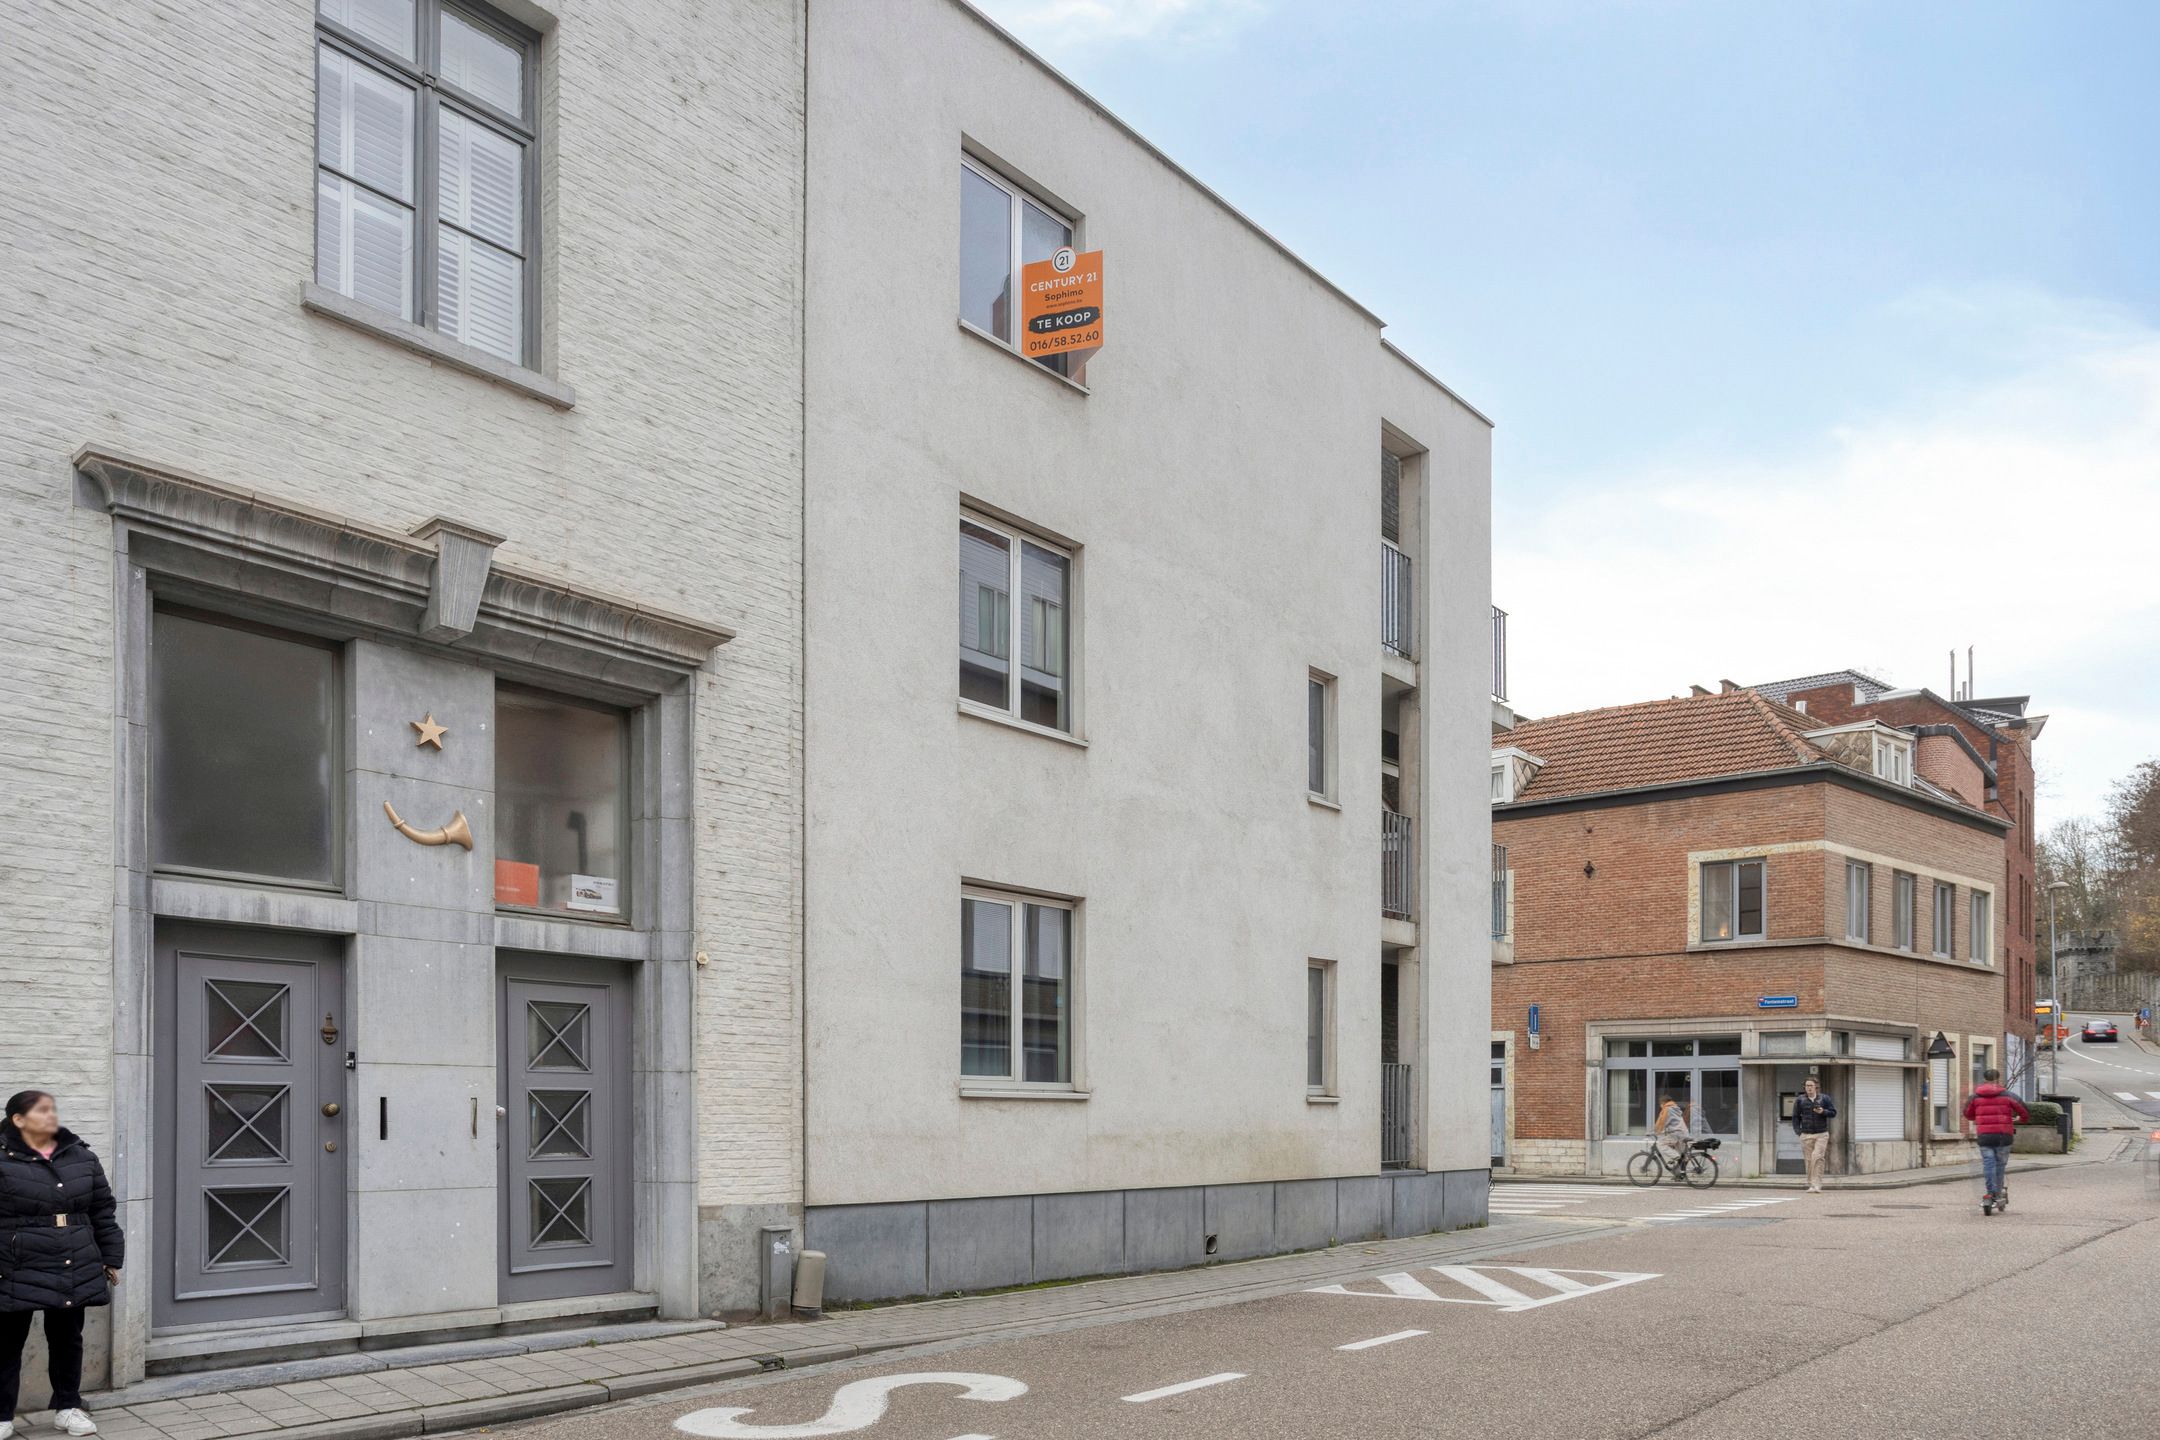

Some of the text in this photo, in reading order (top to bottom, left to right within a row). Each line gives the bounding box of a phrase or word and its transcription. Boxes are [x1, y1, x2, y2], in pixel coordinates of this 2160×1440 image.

[1030, 272, 1097, 292] CENTURY 21
[1045, 289, 1084, 302] Sophimo
[1036, 311, 1091, 329] TE KOOP
[1030, 330, 1099, 351] 016/58.52.60
